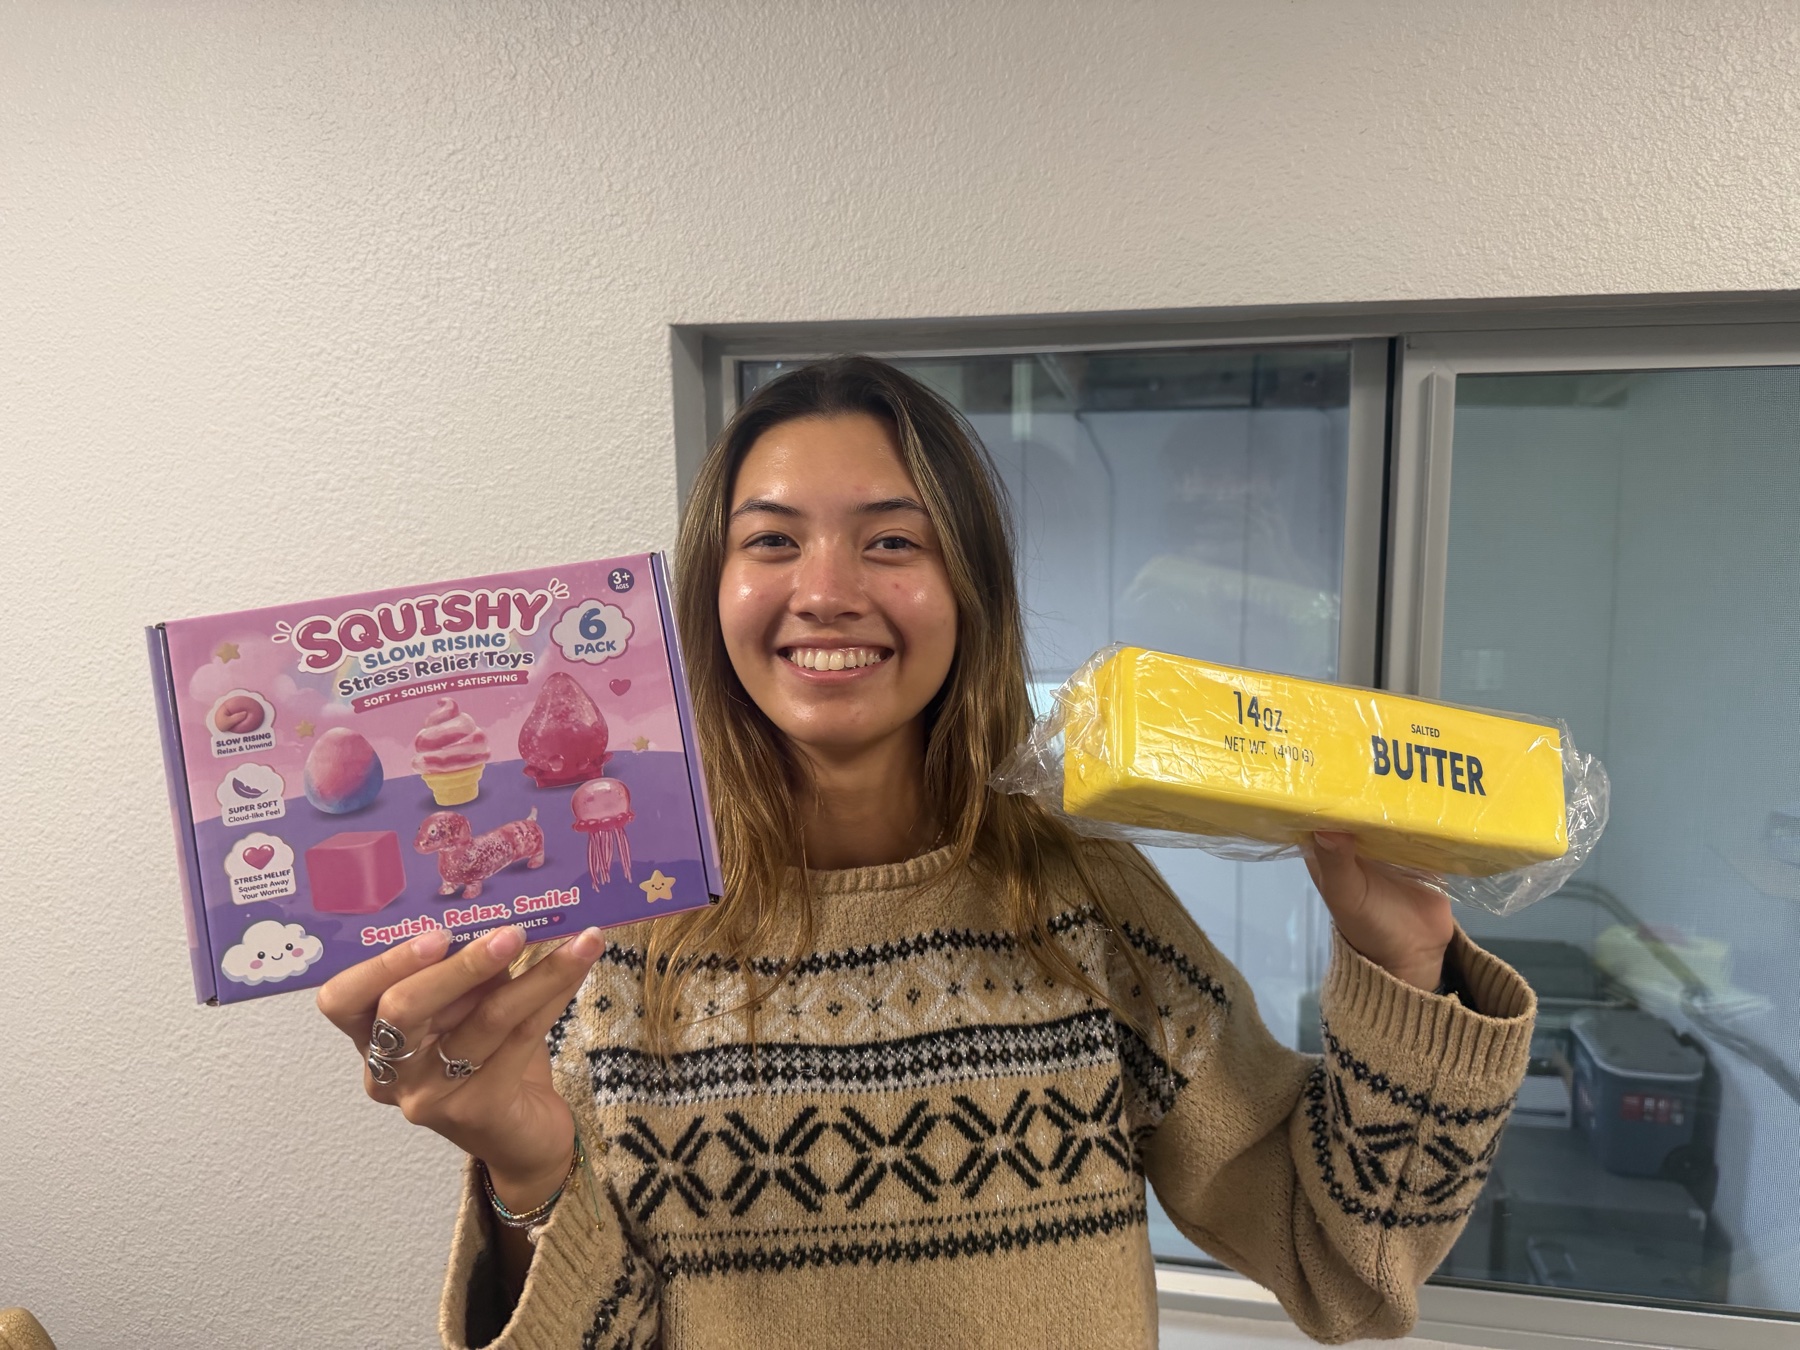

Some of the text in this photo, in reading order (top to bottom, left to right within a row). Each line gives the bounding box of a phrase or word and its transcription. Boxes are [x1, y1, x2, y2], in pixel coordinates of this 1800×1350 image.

[612, 571, 630, 584] 3+
[298, 592, 548, 669] SQUISHY
[579, 608, 606, 640] 6
[363, 633, 506, 669] SLOW RISING
[574, 640, 617, 656] PACK
[338, 651, 534, 696] Stress Relief Toys
[363, 673, 518, 707] SOFT SQUISHY SATISFYING
[1410, 723, 1440, 738] SALTED
[216, 732, 271, 747] SLOW RISING
[1224, 735, 1245, 752] NET
[216, 747, 237, 755] Relax
[245, 741, 272, 751] Unwind
[1371, 735, 1486, 796] BUTTER
[228, 800, 278, 814] SUPER SOFT
[228, 809, 281, 823] Cloud-like Feel
[234, 874, 262, 885] STRESS
[238, 879, 289, 893] Squeeze Away
[260, 887, 288, 897] Worries
[362, 888, 578, 944] Squish, Relax, Smile!
[450, 932, 470, 943] FOR
